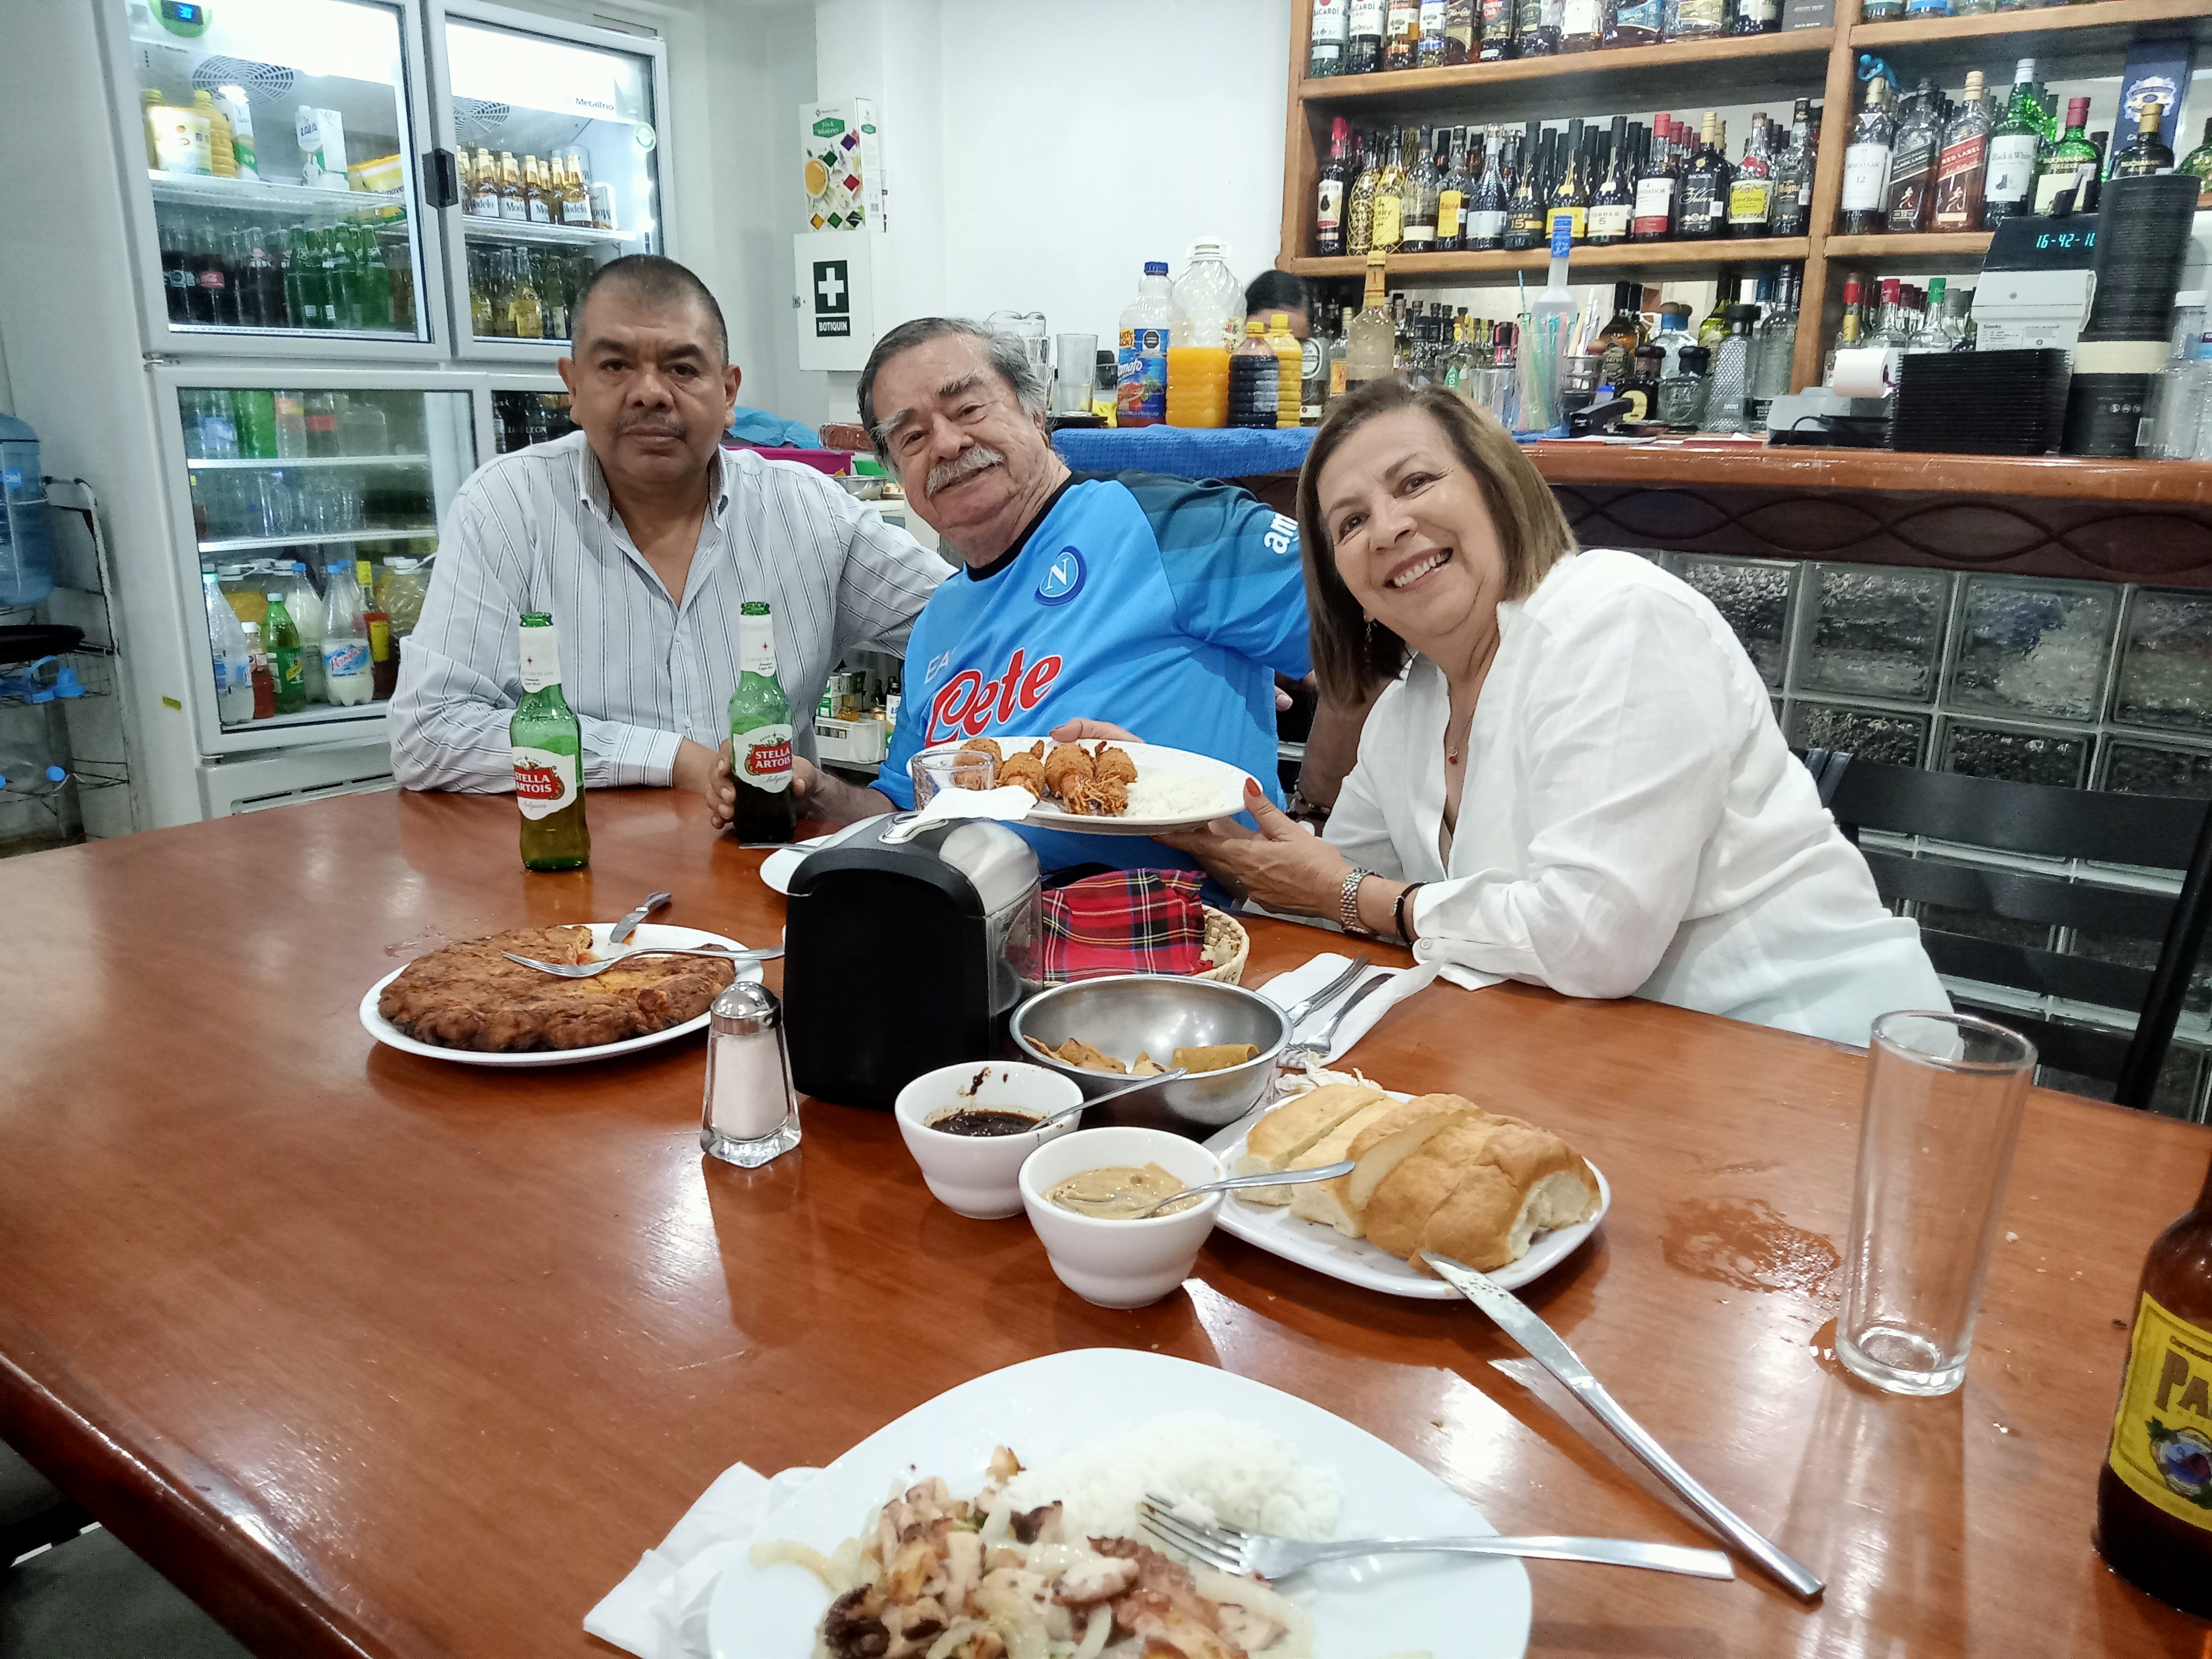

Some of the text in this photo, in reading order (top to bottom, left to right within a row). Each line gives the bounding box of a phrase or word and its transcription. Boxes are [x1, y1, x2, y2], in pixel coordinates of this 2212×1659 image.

[576, 98, 614, 110] Metalfrio
[1941, 146, 1981, 165] RED LABEL
[1511, 219, 1524, 229] 15
[819, 321, 847, 332] BOTIQUIN
[1044, 558, 1070, 591] N
[925, 646, 957, 684] EA
[755, 747, 791, 759] STELLA
[755, 756, 791, 768] ARTOIS
[515, 772, 551, 783] STELLA
[2154, 1348, 2212, 1421] PA
